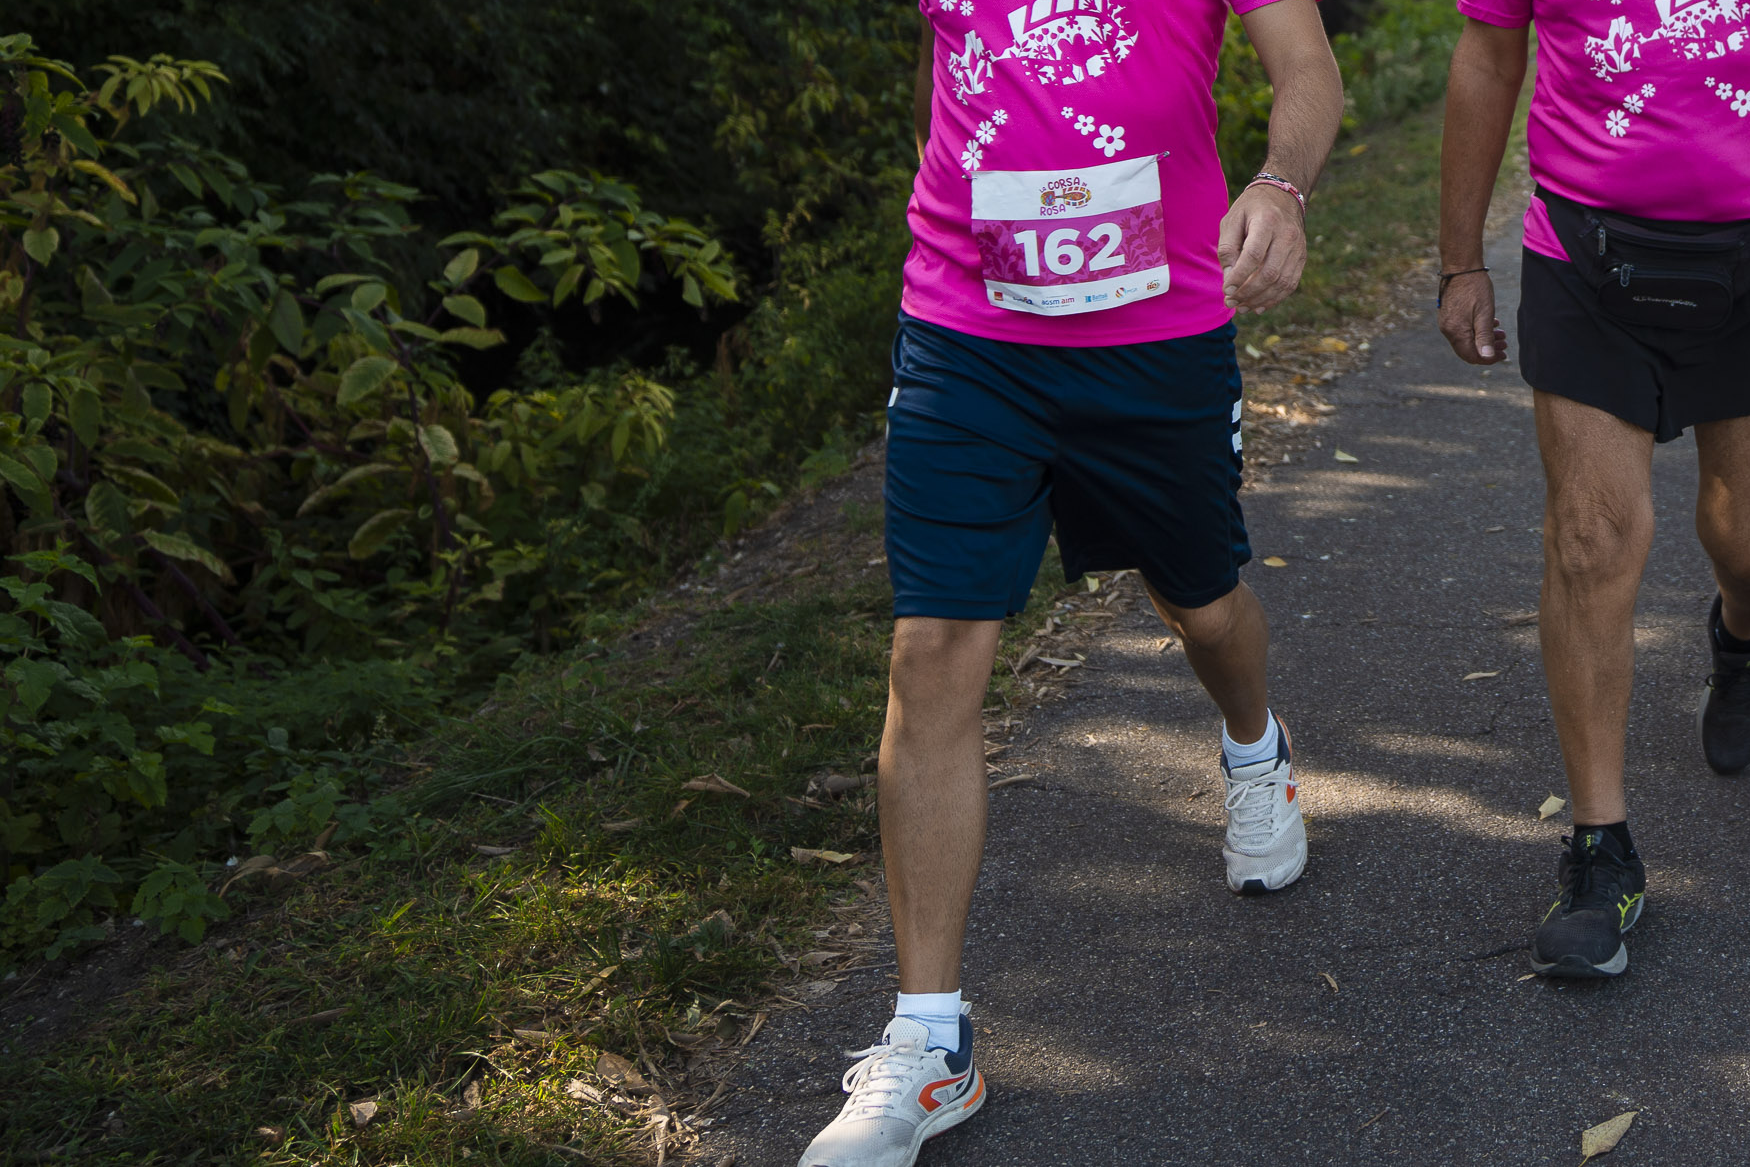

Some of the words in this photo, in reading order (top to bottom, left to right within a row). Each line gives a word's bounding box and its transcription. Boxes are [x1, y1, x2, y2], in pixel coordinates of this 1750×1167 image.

[1047, 176, 1081, 191] CORSA
[1040, 203, 1066, 216] ROSA
[1013, 222, 1126, 277] 162
